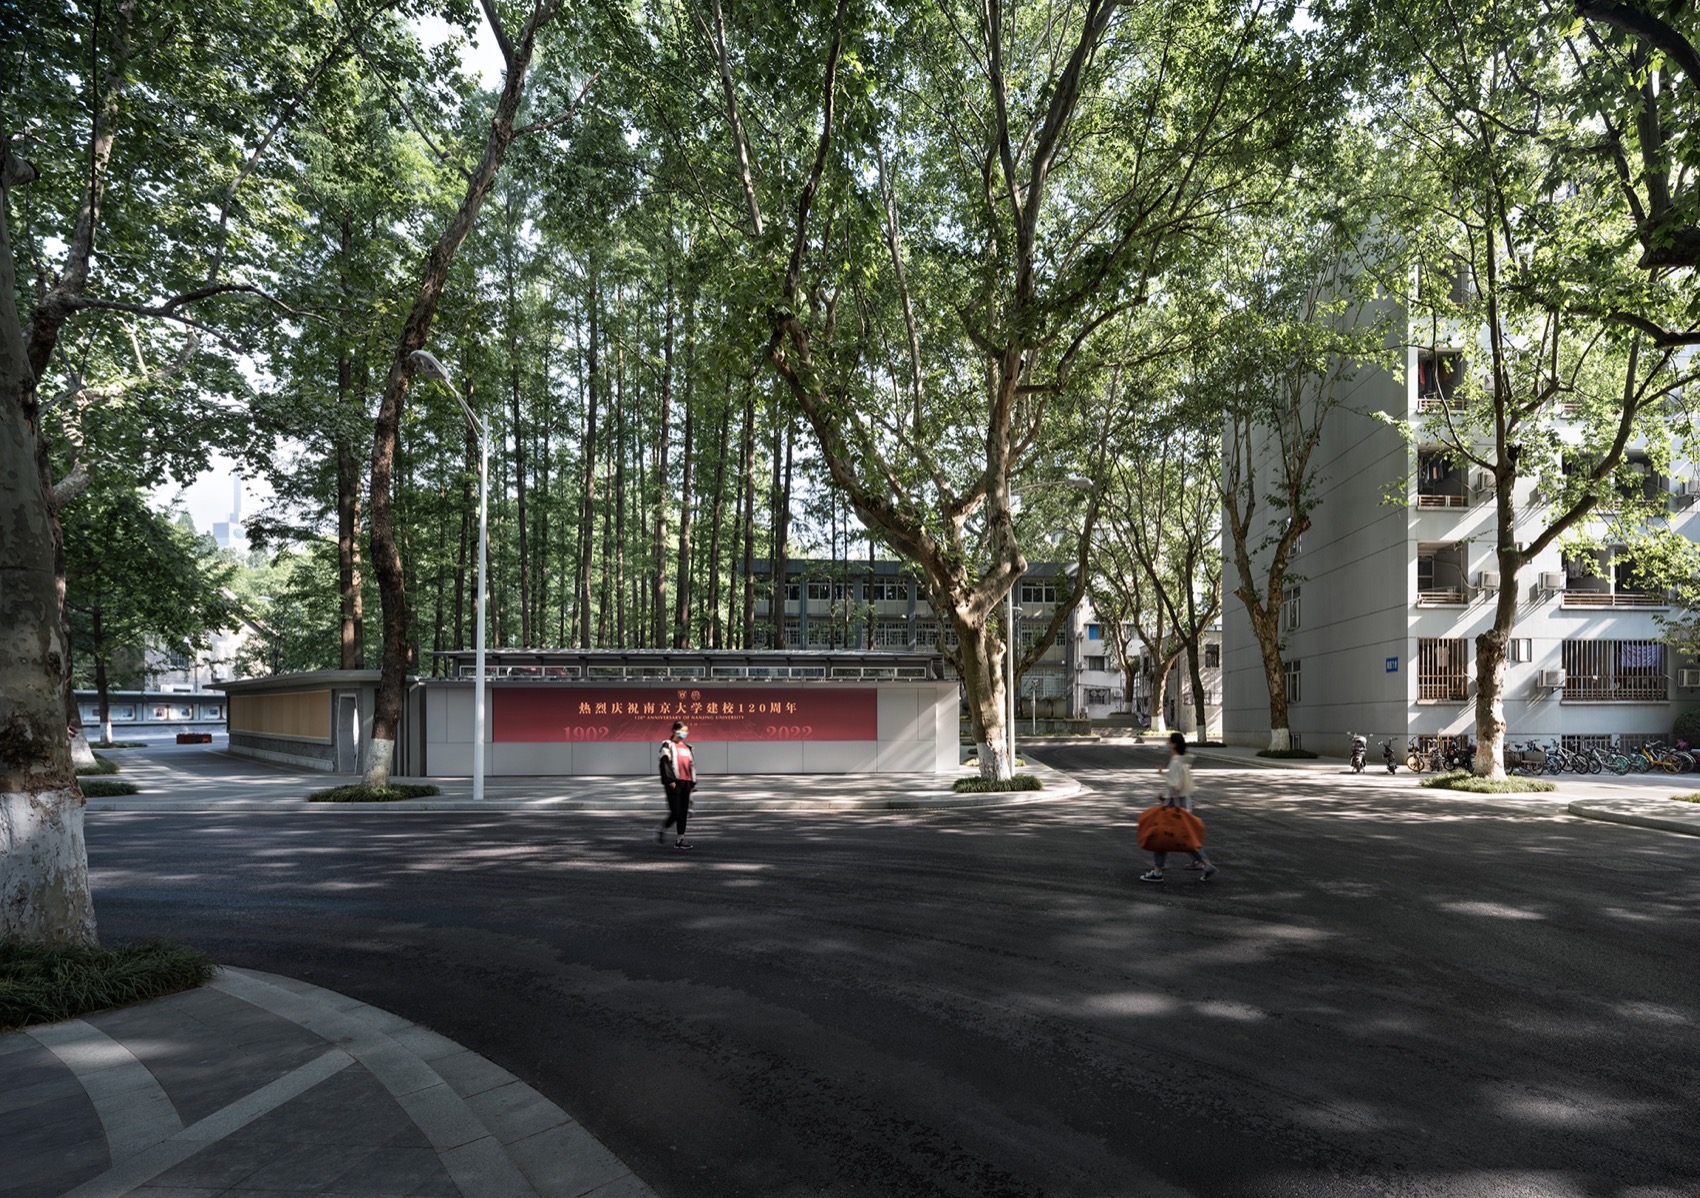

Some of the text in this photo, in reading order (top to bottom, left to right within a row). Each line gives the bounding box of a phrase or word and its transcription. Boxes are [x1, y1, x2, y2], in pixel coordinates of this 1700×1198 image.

[578, 702, 797, 714] 热烈庆祝南京大学建校120周年
[563, 726, 609, 740] 1902
[766, 725, 812, 740] 2022
